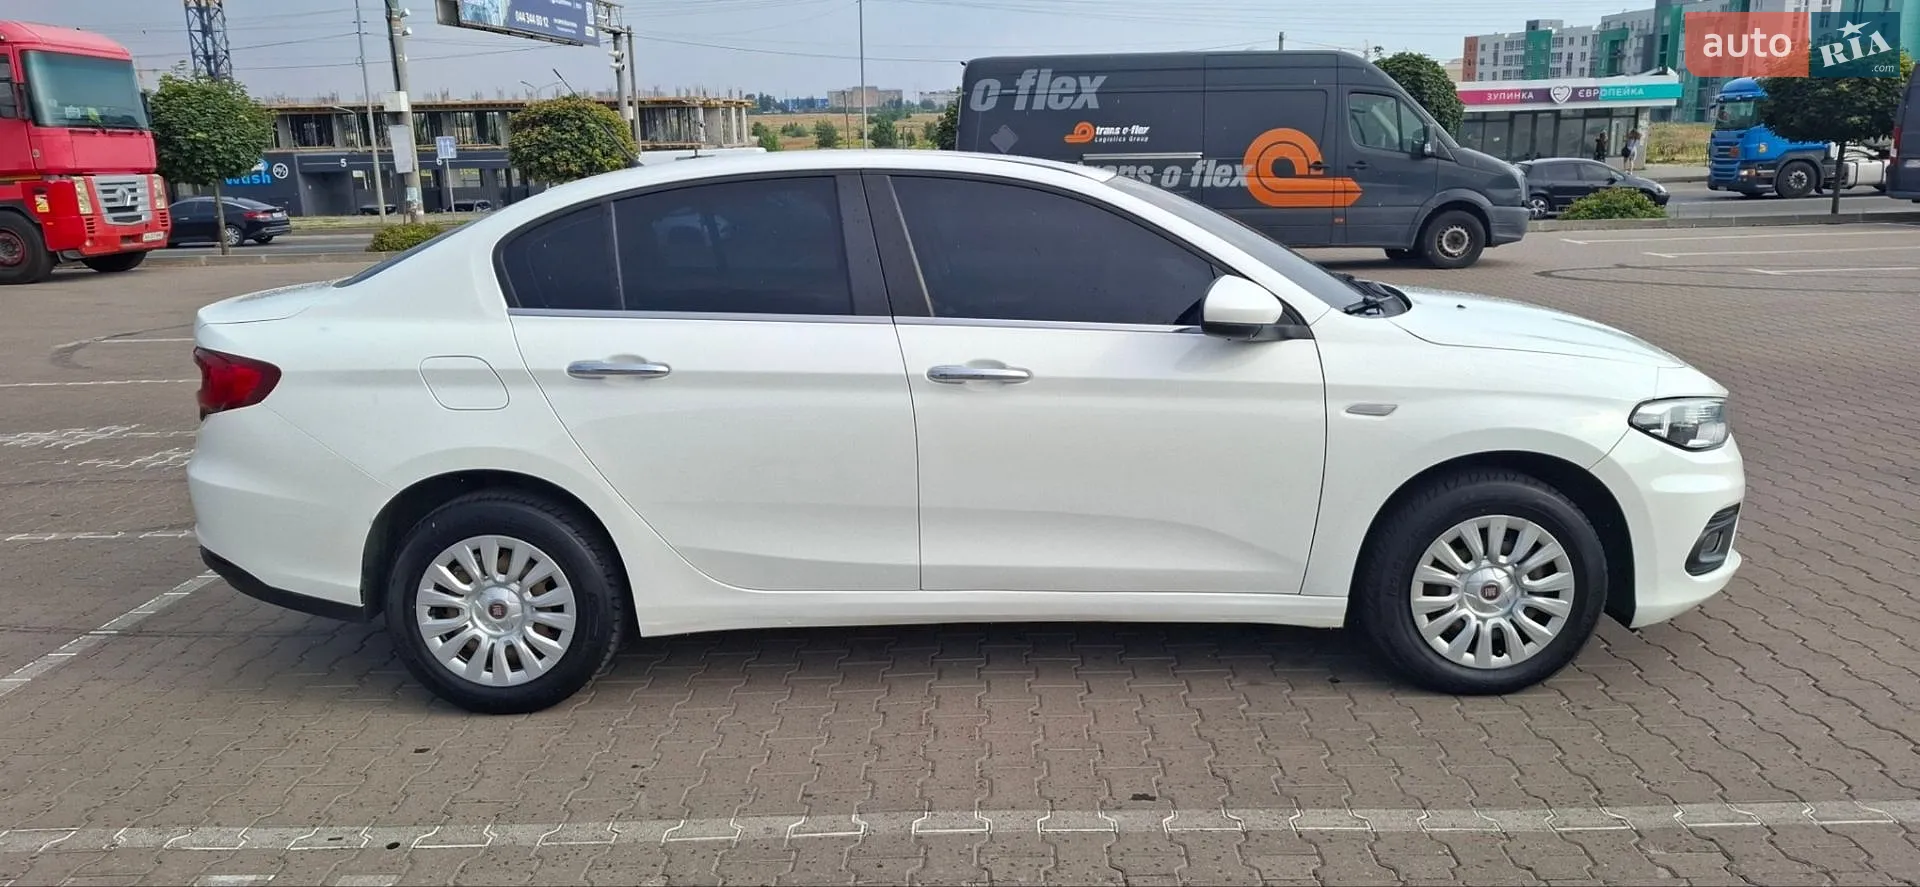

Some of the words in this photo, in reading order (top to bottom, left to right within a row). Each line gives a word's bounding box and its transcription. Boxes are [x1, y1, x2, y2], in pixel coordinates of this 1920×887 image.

[1487, 91, 1534, 101] ЗУПИНКА
[1578, 86, 1644, 98] ЄВРОПЕЙКА
[1095, 125, 1121, 136] trans
[340, 158, 347, 168] 5
